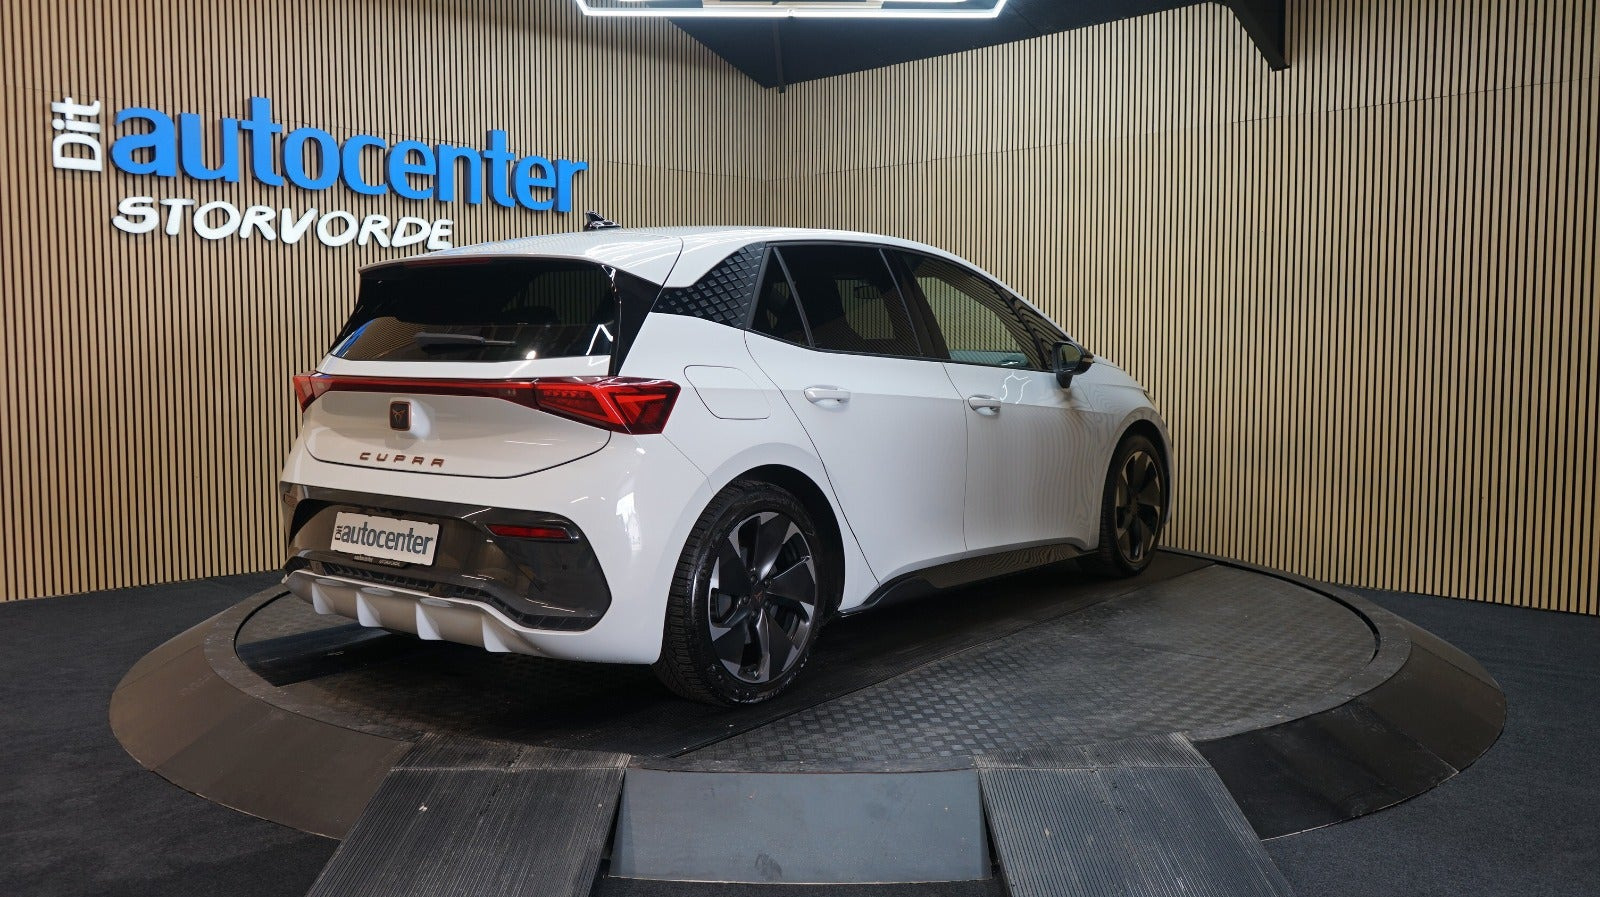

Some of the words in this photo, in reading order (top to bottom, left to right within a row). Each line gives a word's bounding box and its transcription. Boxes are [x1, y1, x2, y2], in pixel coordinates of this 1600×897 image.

[51, 96, 102, 171] Dit
[109, 97, 588, 213] autocenter
[112, 196, 454, 250] STORVORDE
[360, 452, 444, 467] CUPRA
[341, 521, 433, 555] autocenter
